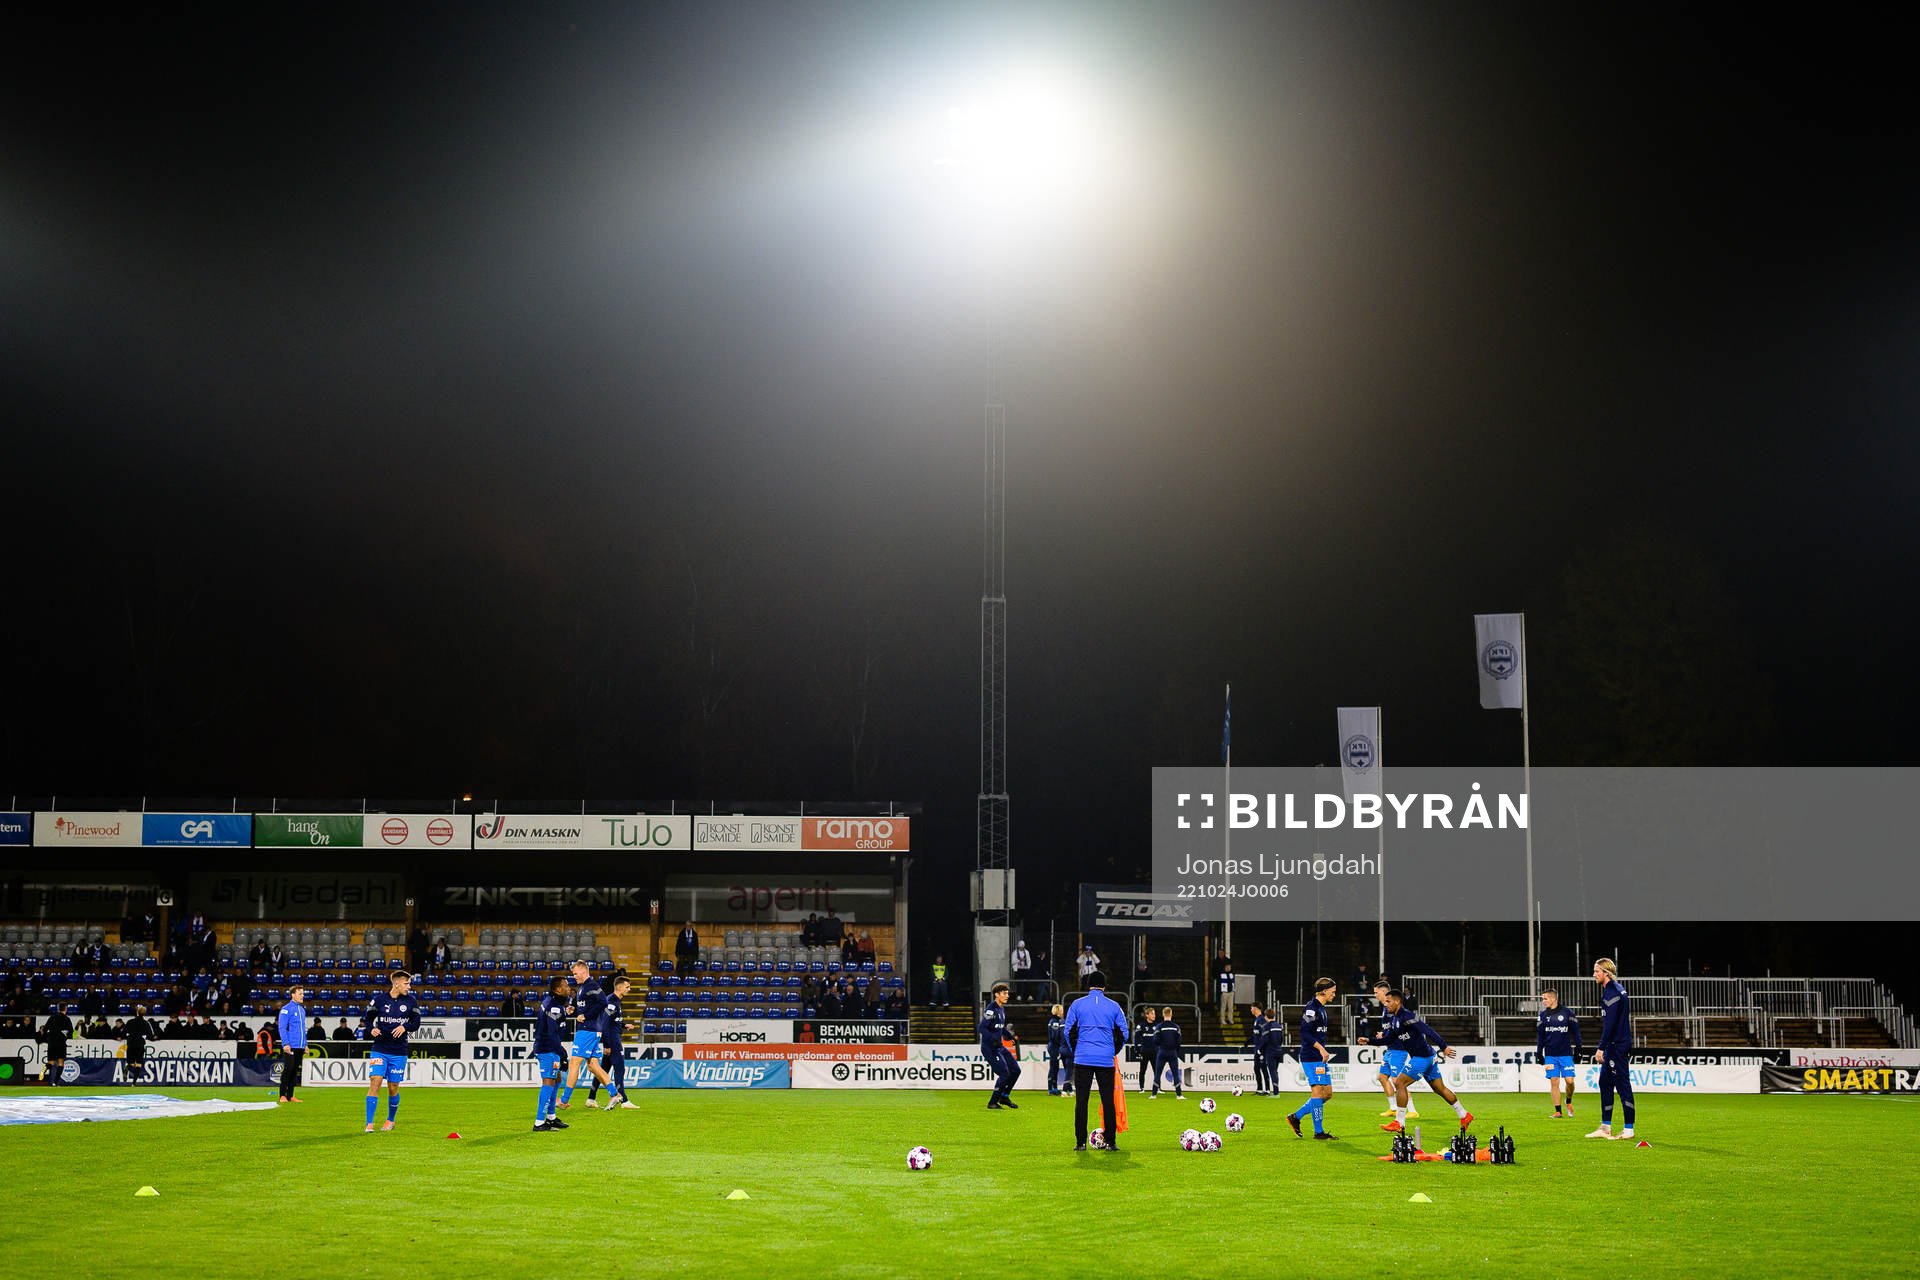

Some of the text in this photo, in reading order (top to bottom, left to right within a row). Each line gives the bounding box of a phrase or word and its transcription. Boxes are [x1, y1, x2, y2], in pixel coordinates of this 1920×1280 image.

[66, 821, 120, 836] Pinewood
[180, 820, 213, 839] GA
[287, 818, 320, 834] hang
[504, 828, 581, 838] DIN MASKIN
[709, 823, 742, 833] KONST
[763, 823, 796, 833] KONST
[816, 819, 894, 839] ramo
[310, 831, 330, 845] On
[709, 833, 742, 843] SMIDE
[763, 833, 796, 843] SMIDE
[855, 839, 894, 849] GROUP
[246, 877, 397, 910] Liljedahl
[445, 886, 640, 906] ZINKTEKNIK
[727, 880, 836, 919] aperit
[1096, 903, 1192, 917] TROAX
[719, 1031, 766, 1042] HORDA
[820, 1025, 895, 1037] BEMANNINGS
[695, 1050, 704, 1059] Vi
[706, 1050, 719, 1059] lär
[721, 1050, 736, 1059] IFK
[738, 1050, 785, 1060] Värnamos
[787, 1051, 834, 1060] ungdomar
[853, 1051, 895, 1061] ekonomi
[431, 1061, 538, 1081] NOMINIT
[683, 1061, 766, 1087] Windings
[854, 1063, 967, 1081] Finnvedens
[1199, 1072, 1255, 1086] gjuteritekni
